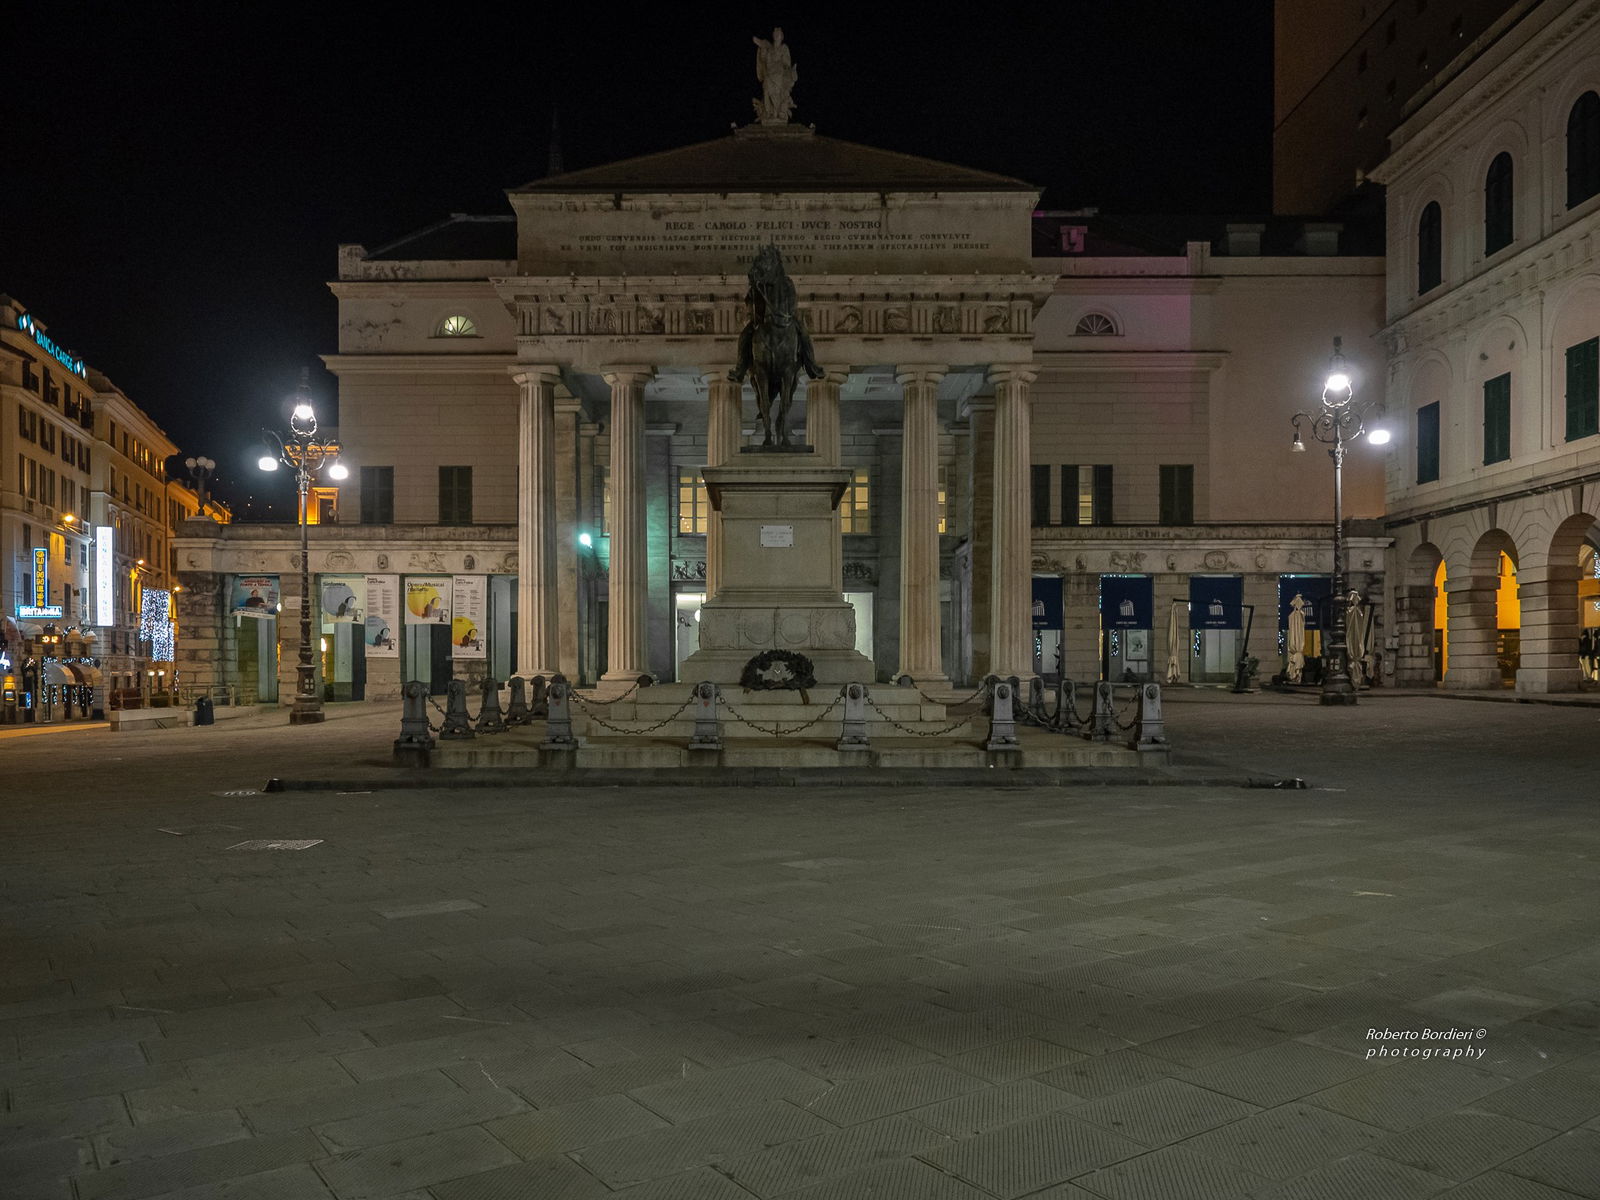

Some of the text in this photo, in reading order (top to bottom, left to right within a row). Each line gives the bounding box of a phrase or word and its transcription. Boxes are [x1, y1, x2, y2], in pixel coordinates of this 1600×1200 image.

[705, 222, 746, 230] CAROLO
[756, 222, 792, 230] FELICI
[802, 221, 830, 229] DVCE
[840, 221, 882, 229] NOSTRO
